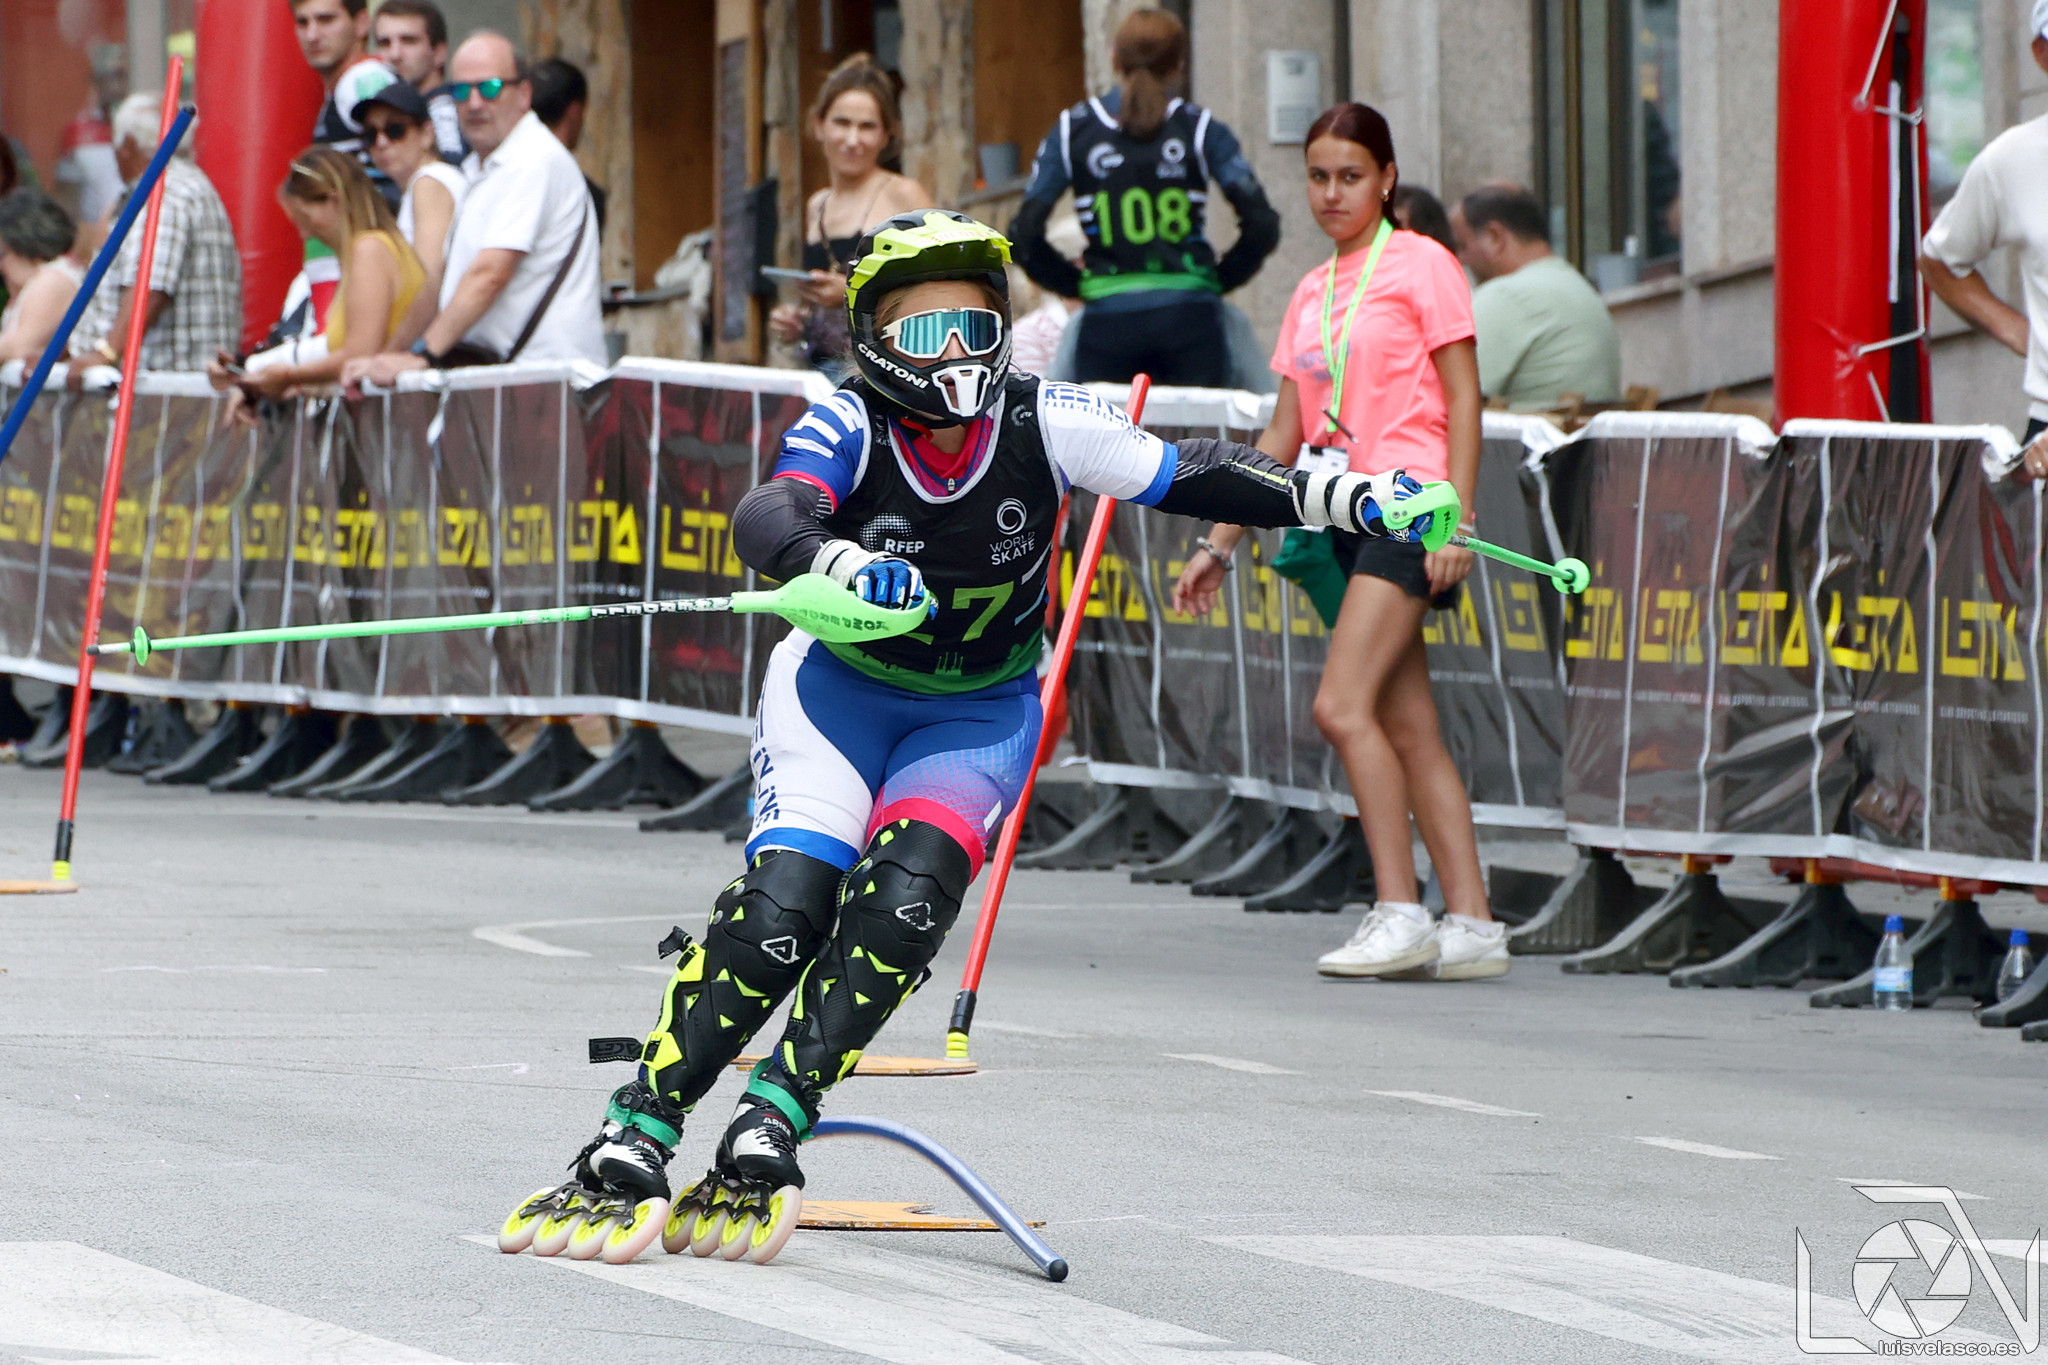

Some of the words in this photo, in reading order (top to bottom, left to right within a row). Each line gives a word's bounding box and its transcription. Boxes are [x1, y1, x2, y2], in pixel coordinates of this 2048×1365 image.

[1093, 187, 1192, 247] 108
[857, 343, 929, 389] CRATONI
[884, 538, 925, 553] RFEP
[989, 531, 1036, 553] WORLD
[990, 539, 1035, 566] SKATE
